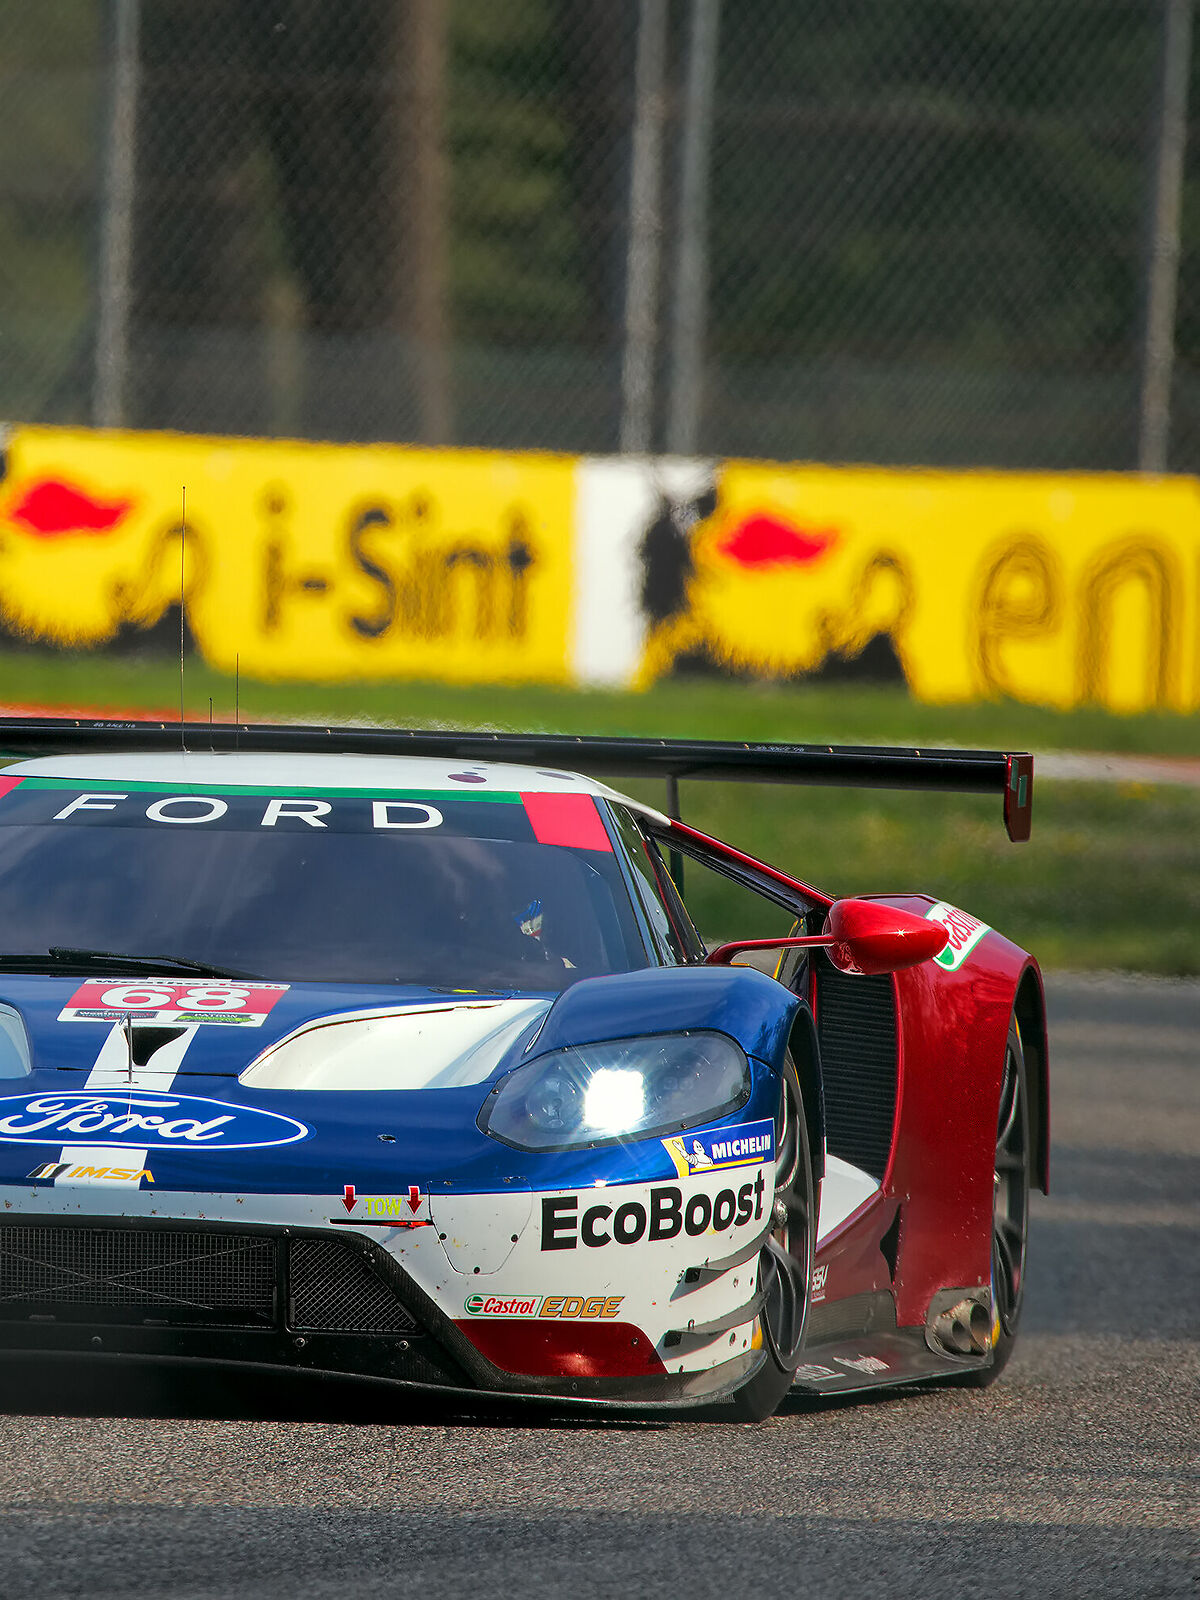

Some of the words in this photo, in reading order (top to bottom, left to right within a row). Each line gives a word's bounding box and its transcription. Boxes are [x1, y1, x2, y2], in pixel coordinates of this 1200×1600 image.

[257, 479, 534, 641] i-Sint
[53, 794, 445, 830] FORD
[100, 985, 251, 1010] 68
[711, 1134, 771, 1160] MICHELIN
[67, 1166, 155, 1183] IMSA
[364, 1198, 402, 1216] TOW
[540, 1168, 766, 1252] EcoBoost
[483, 1297, 536, 1314] Castrol
[539, 1295, 625, 1319] EDGE
